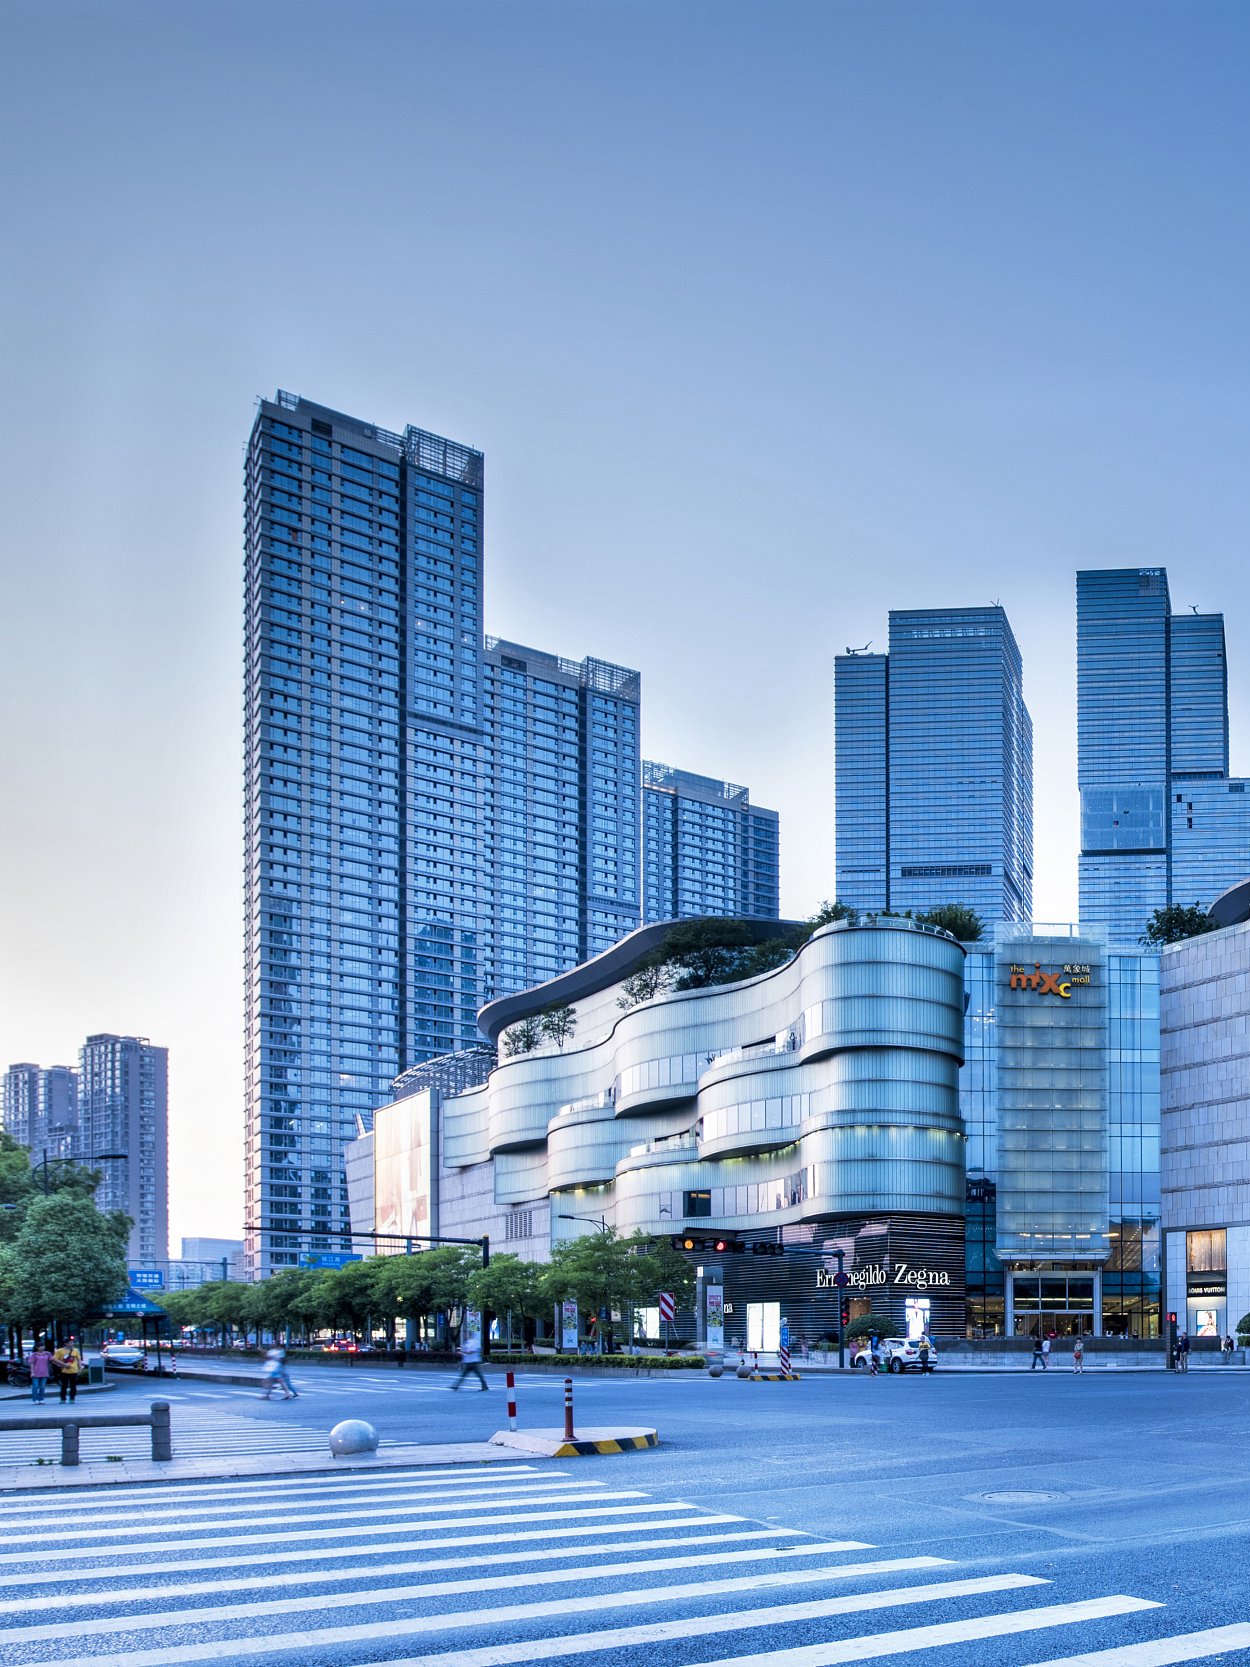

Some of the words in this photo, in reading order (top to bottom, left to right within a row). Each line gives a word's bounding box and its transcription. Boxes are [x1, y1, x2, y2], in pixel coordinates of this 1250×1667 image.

[1010, 964, 1025, 973] the
[1071, 975, 1090, 984] mall
[815, 1264, 887, 1291] Ermnegildo
[893, 1263, 951, 1290] Zegna
[1203, 1286, 1225, 1294] VUITTON
